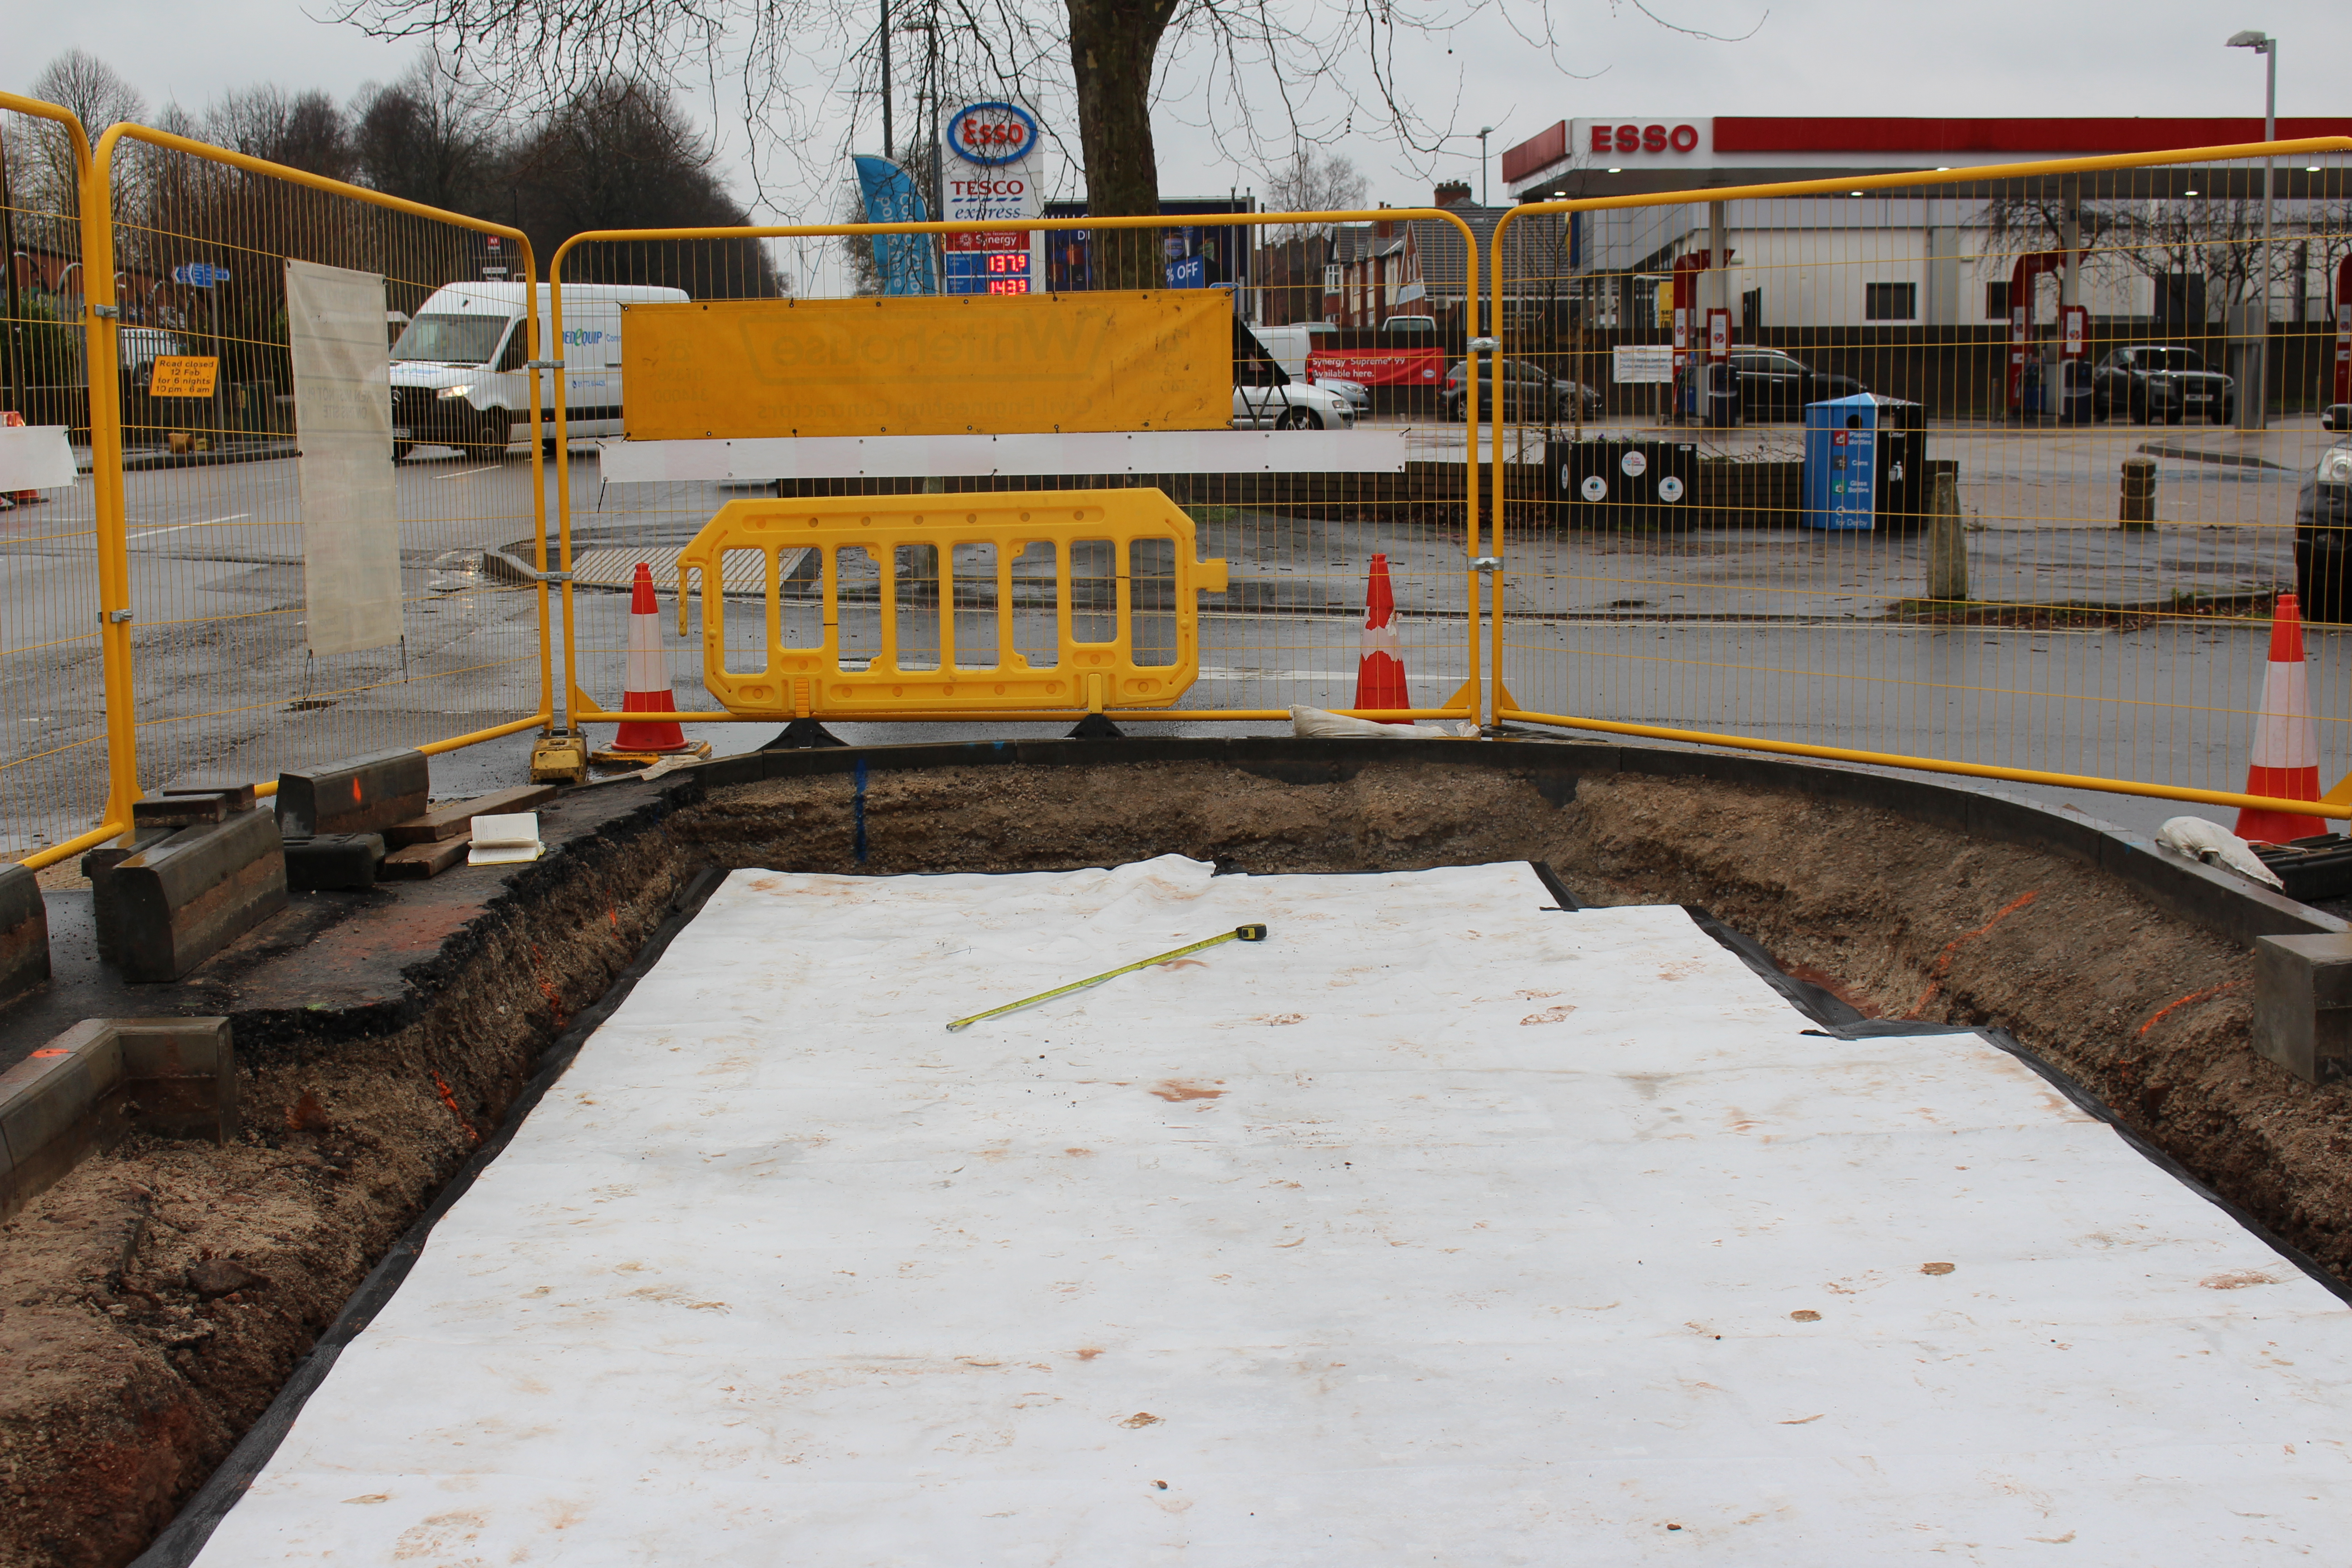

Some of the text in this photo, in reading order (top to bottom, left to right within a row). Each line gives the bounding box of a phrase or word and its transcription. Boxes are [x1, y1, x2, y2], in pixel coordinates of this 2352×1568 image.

[1591, 125, 1698, 152] ESSO
[950, 180, 1024, 195] TESCO
[955, 207, 1021, 221] express
[876, 197, 903, 288] poits here
[900, 193, 923, 294] Collct Club
[976, 235, 1017, 246] Synergy
[1177, 261, 1198, 279] OFF
[1313, 358, 1346, 367] Synergy
[183, 377, 210, 386] nights
